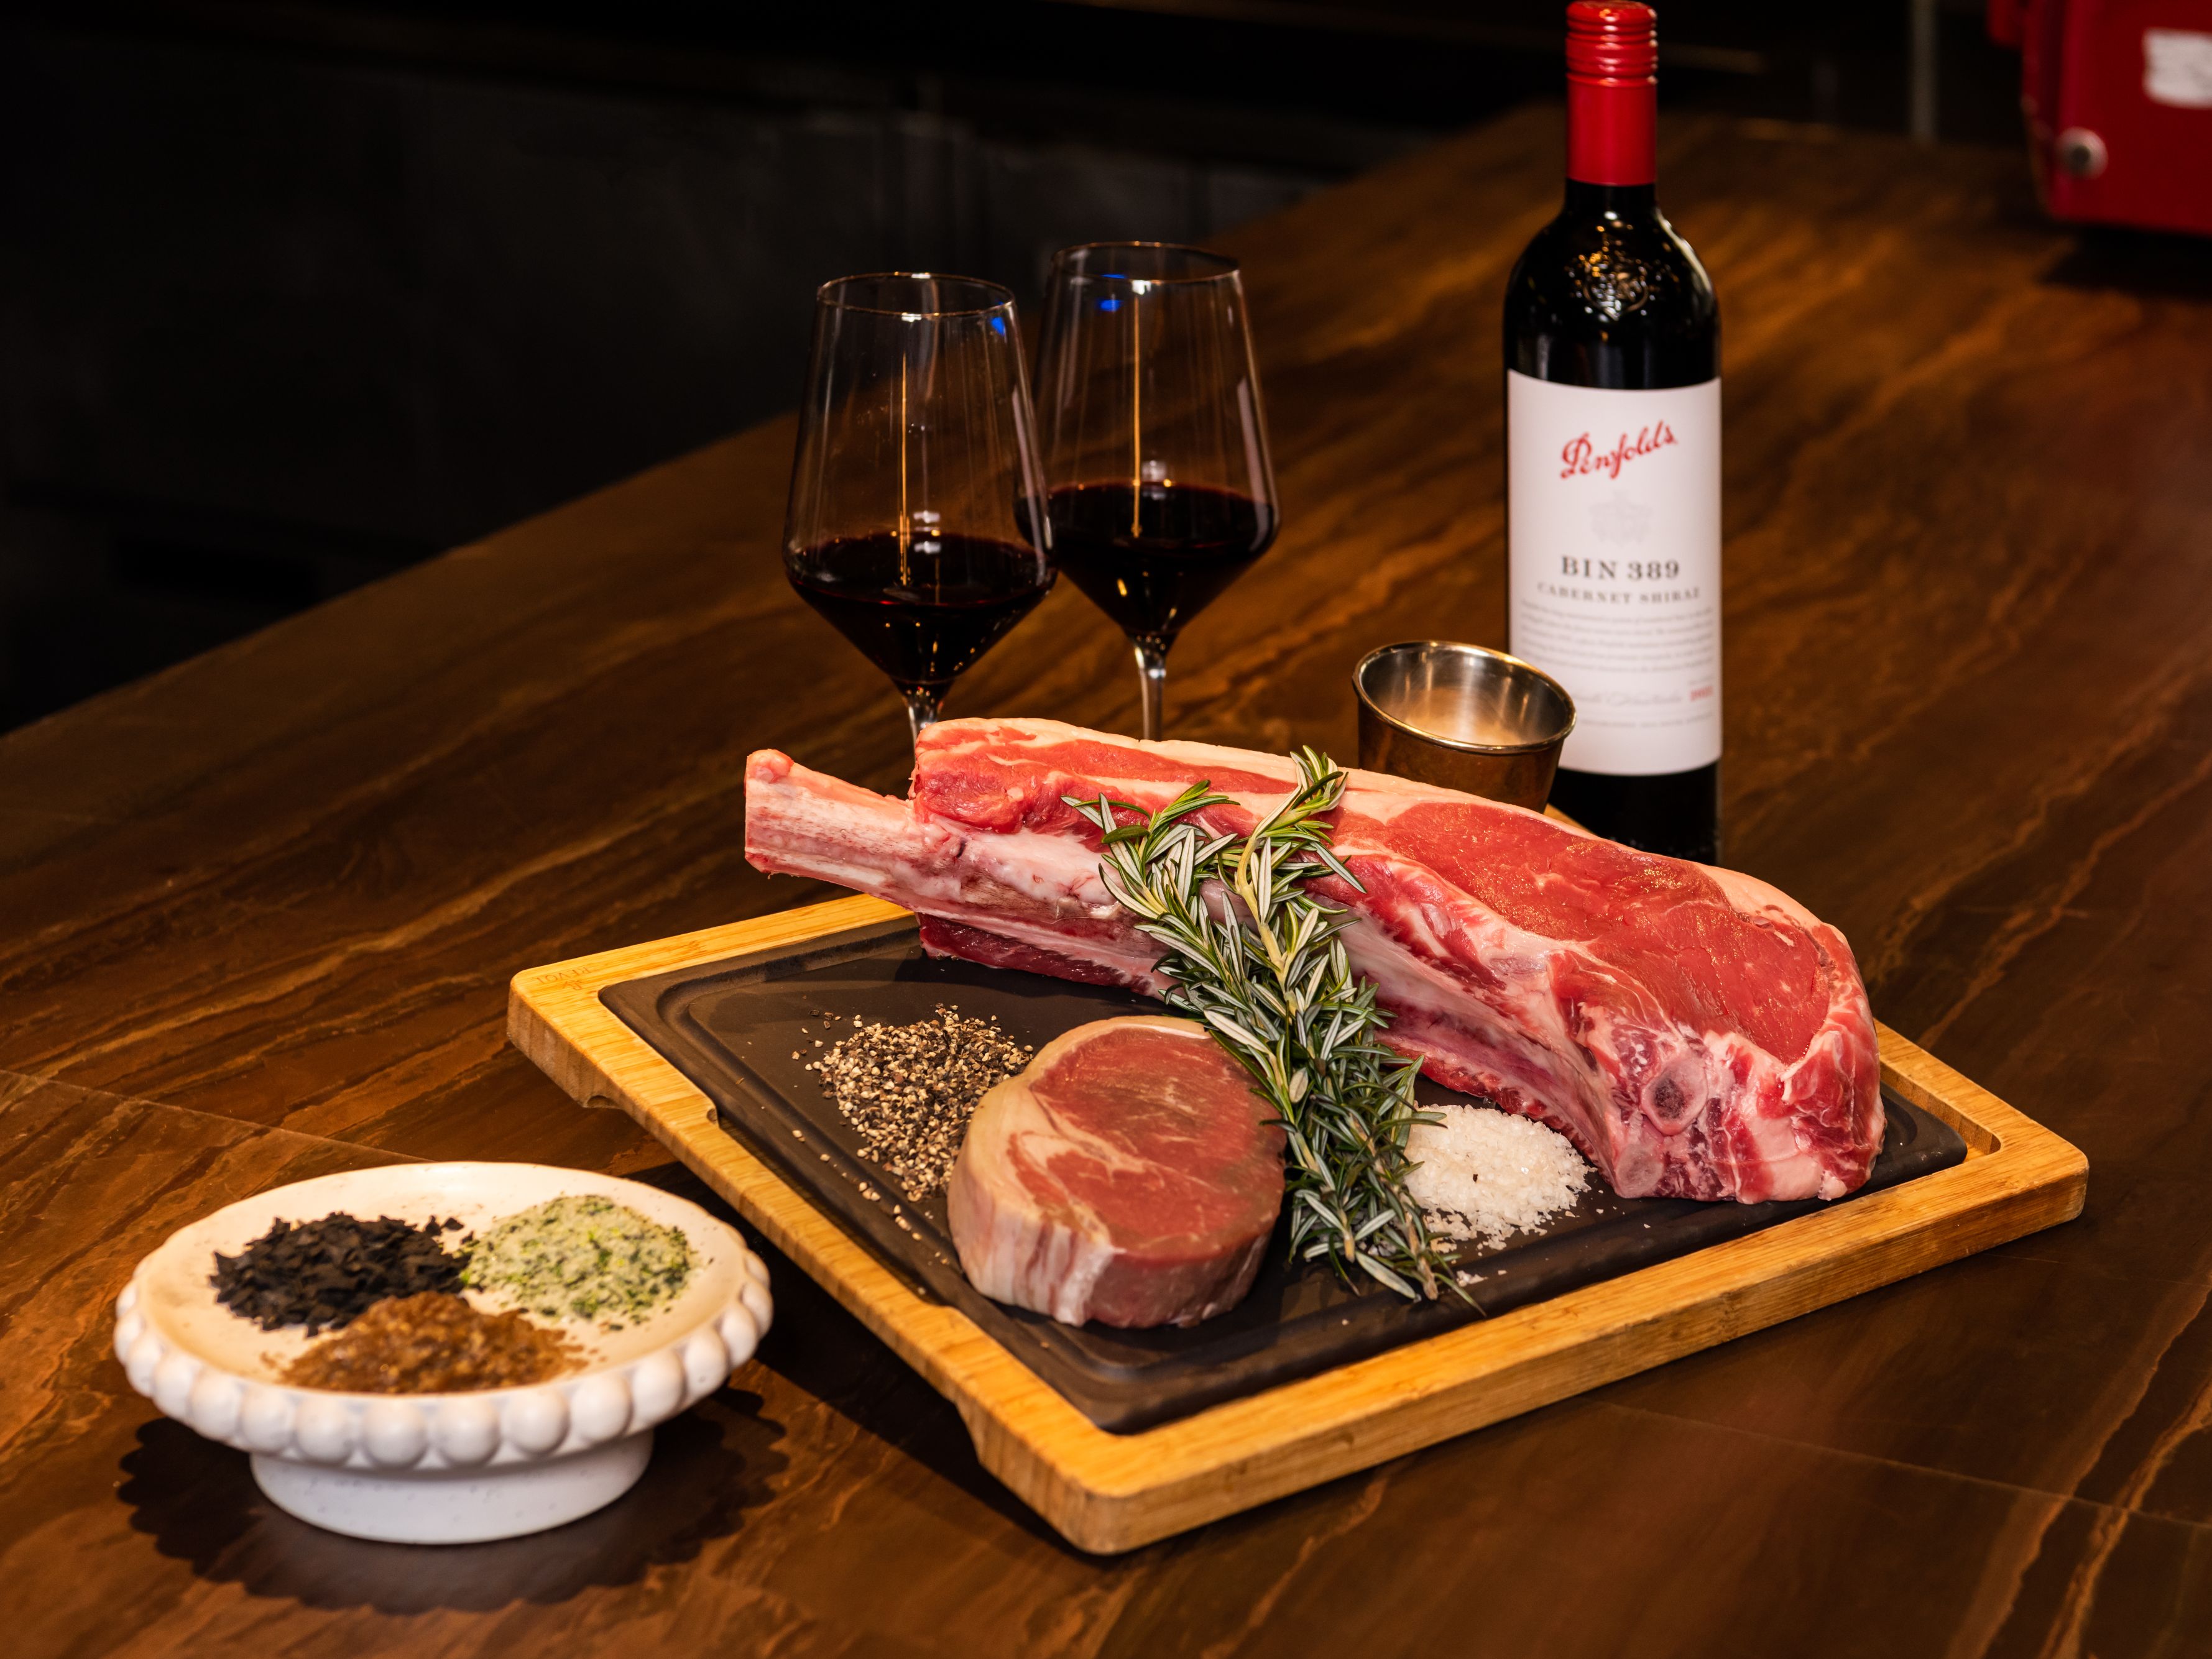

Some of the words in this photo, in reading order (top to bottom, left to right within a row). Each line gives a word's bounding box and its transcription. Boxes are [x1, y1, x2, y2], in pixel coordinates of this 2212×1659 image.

[1560, 420, 1677, 479] Penfolds
[1562, 555, 1616, 579] BIN
[1628, 559, 1679, 580] 389
[1537, 582, 1631, 604] CABERNET
[1640, 587, 1700, 604] SHIRAZ
